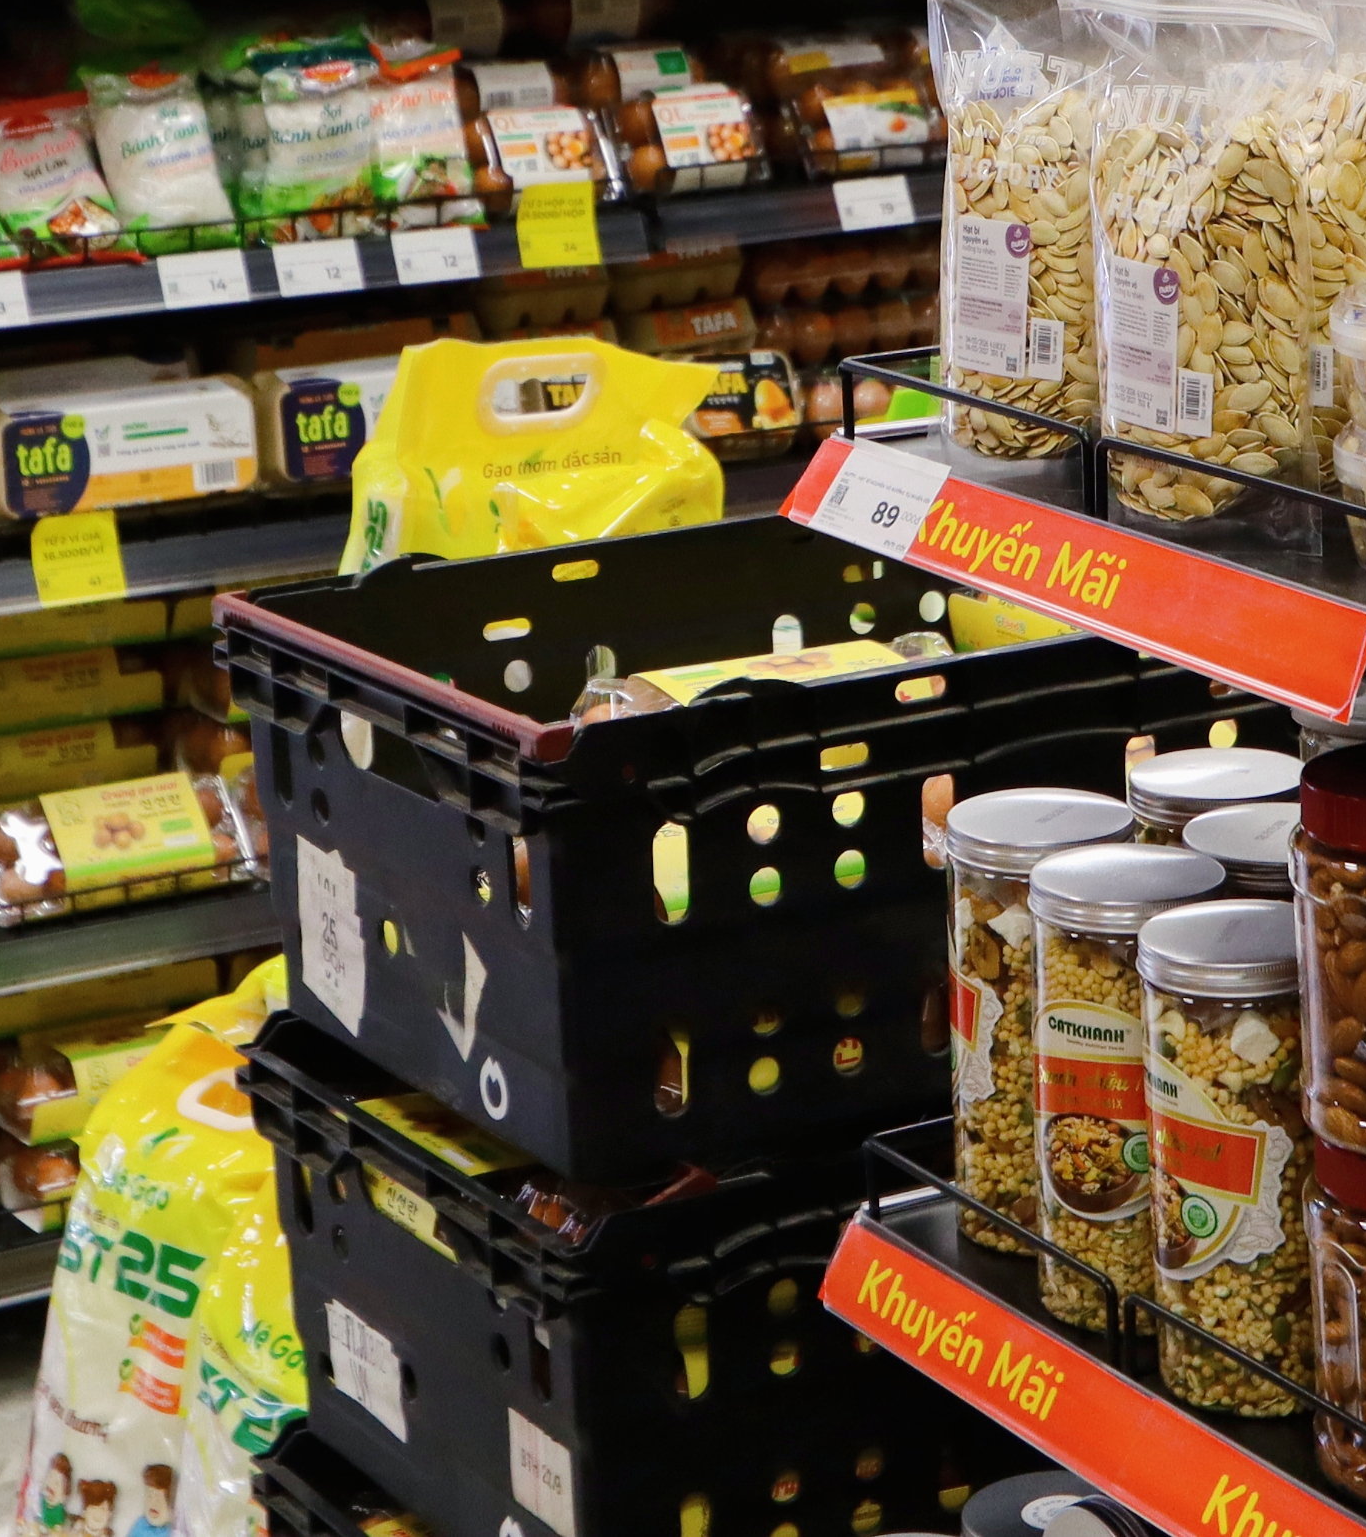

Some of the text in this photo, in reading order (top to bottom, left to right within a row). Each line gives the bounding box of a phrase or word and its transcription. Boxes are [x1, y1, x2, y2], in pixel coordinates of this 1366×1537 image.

[120, 124, 201, 160] Bánh Canh
[317, 120, 353, 140] Canh
[325, 267, 342, 280] 12
[441, 255, 459, 269] 12
[690, 310, 737, 336] TAFA
[712, 371, 749, 395] AFA
[295, 404, 351, 444] tafa
[16, 436, 73, 477] tafa
[870, 501, 900, 528] 89
[1045, 540, 1128, 610] Mãi
[1048, 1015, 1126, 1043] CATKHANH
[58, 1222, 208, 1320] ST25
[856, 1258, 1065, 1422] Khuyến Mãi
[199, 1356, 309, 1455] ST2
